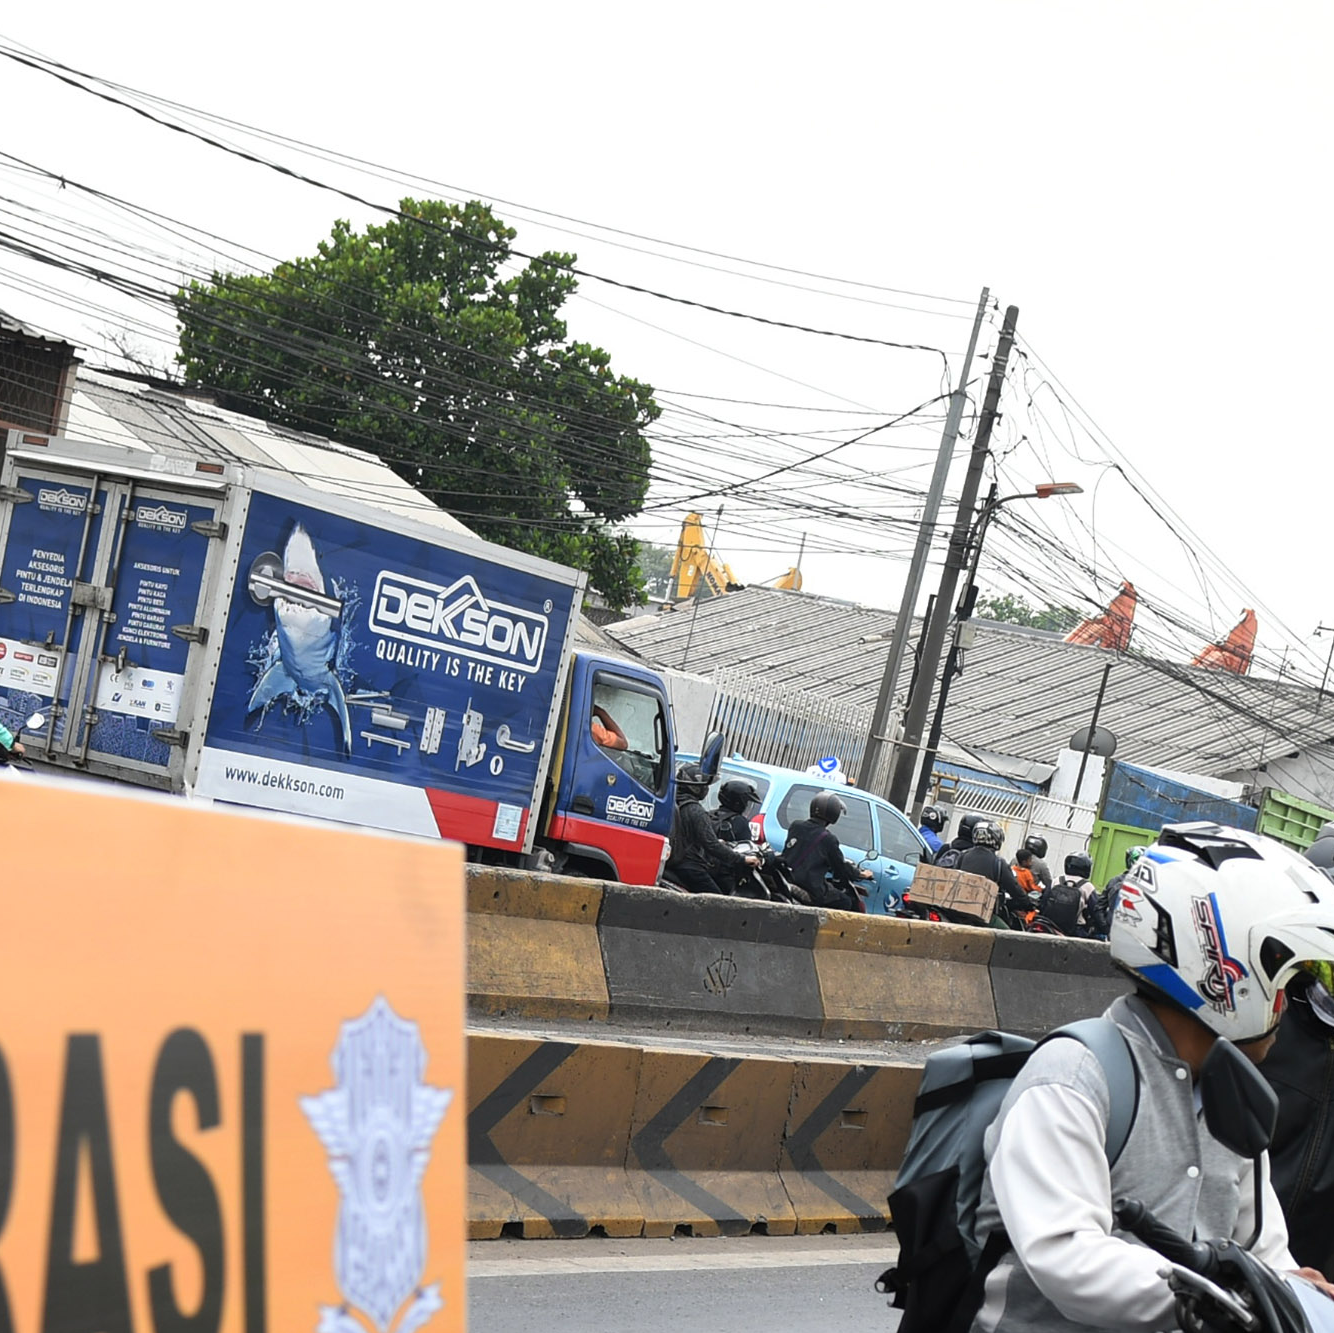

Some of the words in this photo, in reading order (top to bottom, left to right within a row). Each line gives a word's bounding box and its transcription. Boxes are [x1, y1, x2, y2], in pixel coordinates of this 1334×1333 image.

[32, 549, 65, 563] PENYEDIA
[28, 560, 65, 575] AKSESORIS
[15, 569, 36, 581] PINTU
[42, 574, 73, 588] JENDELA
[21, 581, 65, 598] TERLENGKAP
[18, 593, 26, 602] DI
[26, 595, 62, 610] INDONESIA
[375, 639, 441, 672] QUALITY
[445, 656, 461, 677] IS
[467, 661, 494, 685] THE
[498, 670, 527, 693] KEY
[225, 766, 345, 800] www.dekkson.com
